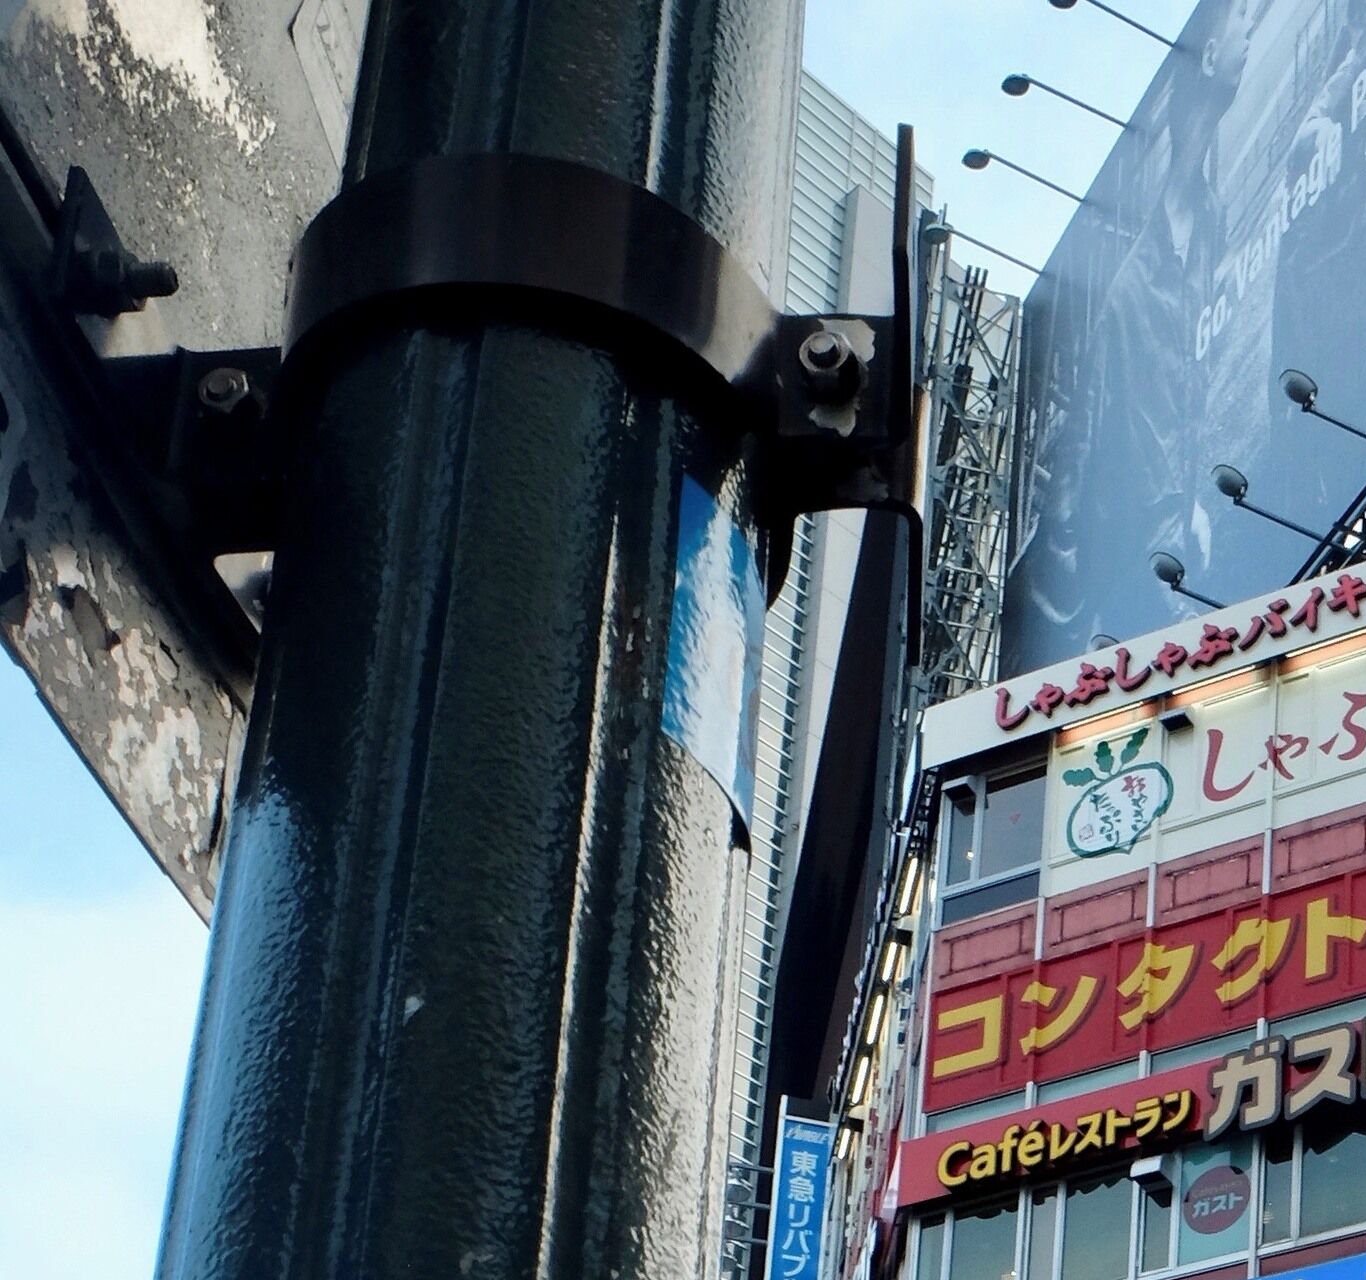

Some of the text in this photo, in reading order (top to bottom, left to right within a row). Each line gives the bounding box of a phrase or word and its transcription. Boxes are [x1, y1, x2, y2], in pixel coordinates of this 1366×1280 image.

[1196, 294, 1232, 361] Go.
[1232, 118, 1343, 301] Vantage
[938, 1088, 1194, 1188] Caféレストラン
[1191, 1192, 1244, 1219] ガスト
